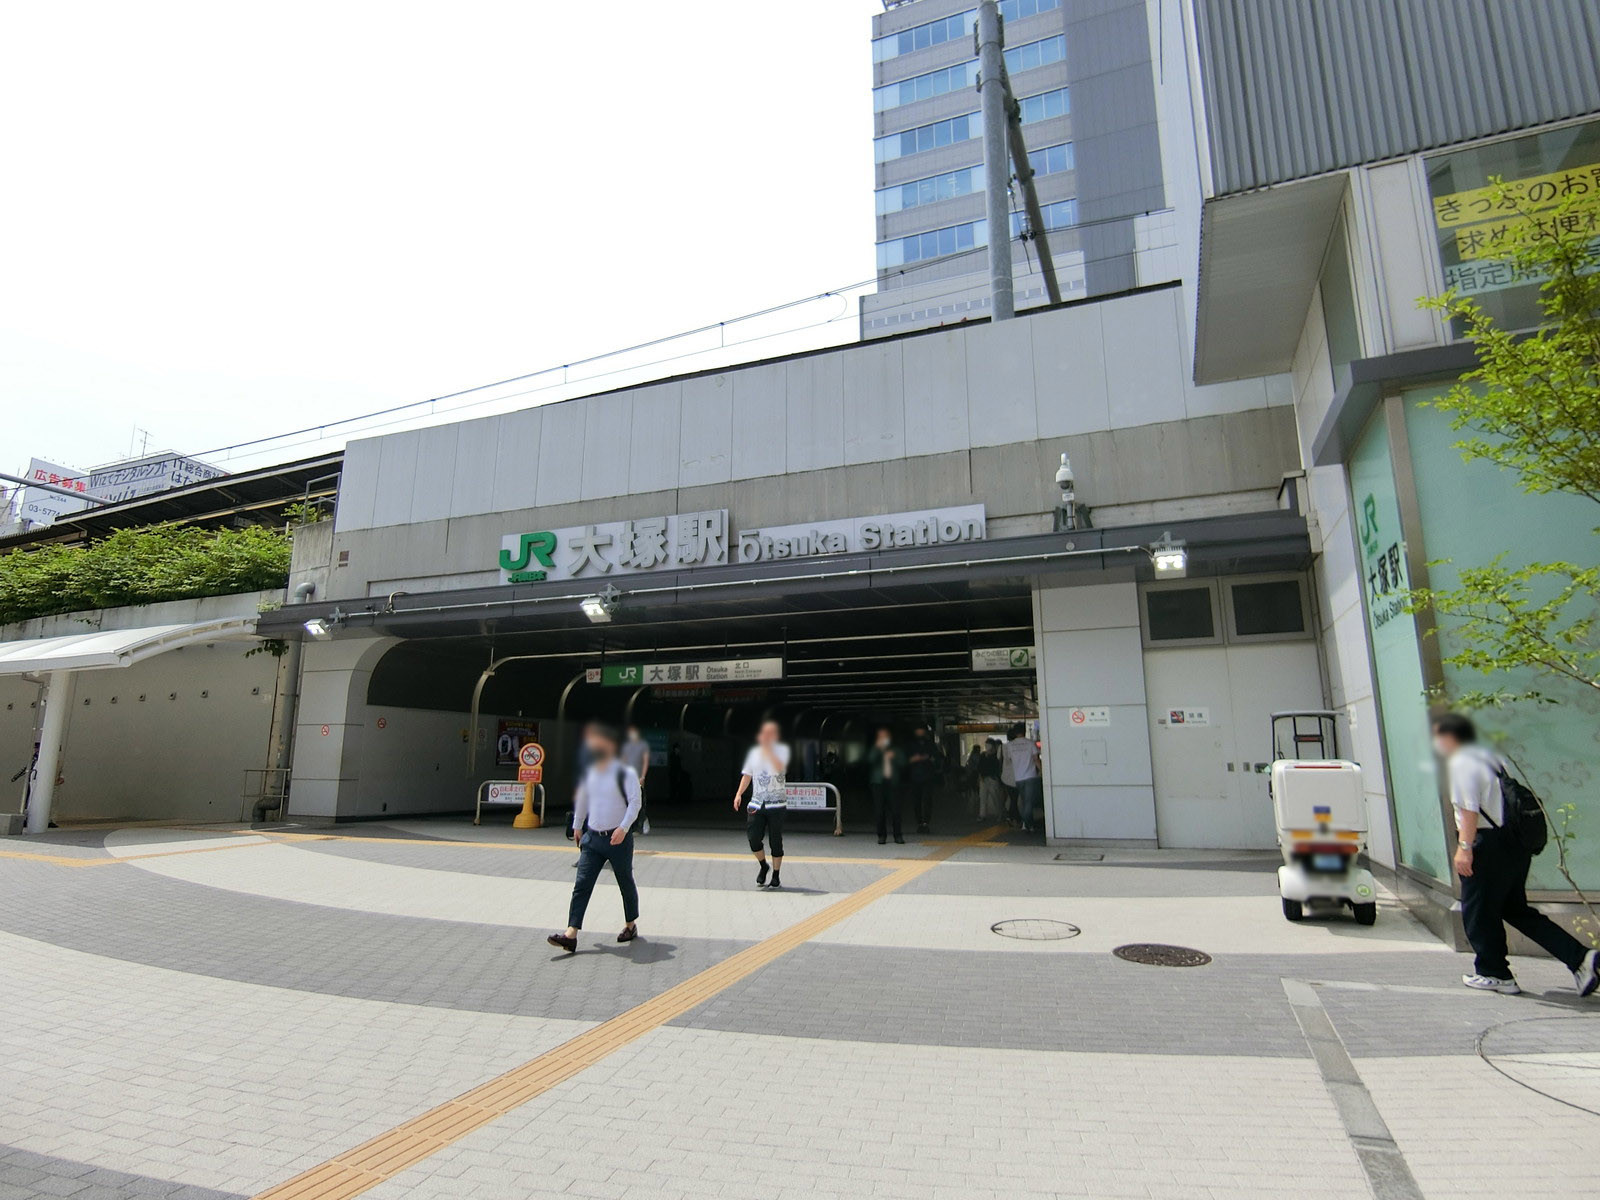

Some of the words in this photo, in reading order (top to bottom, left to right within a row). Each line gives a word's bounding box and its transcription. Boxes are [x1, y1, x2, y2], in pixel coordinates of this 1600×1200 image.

[34, 469, 86, 492] 広告募集
[171, 471, 202, 487] はた
[859, 516, 984, 550] Station
[1360, 493, 1379, 546] JR
[499, 531, 557, 570] JR
[568, 509, 726, 577] 大塚駅
[1368, 542, 1403, 606] 大塚駅
[619, 667, 637, 679] JR
[650, 664, 700, 682] 大塚駅
[735, 661, 749, 669] 北口
